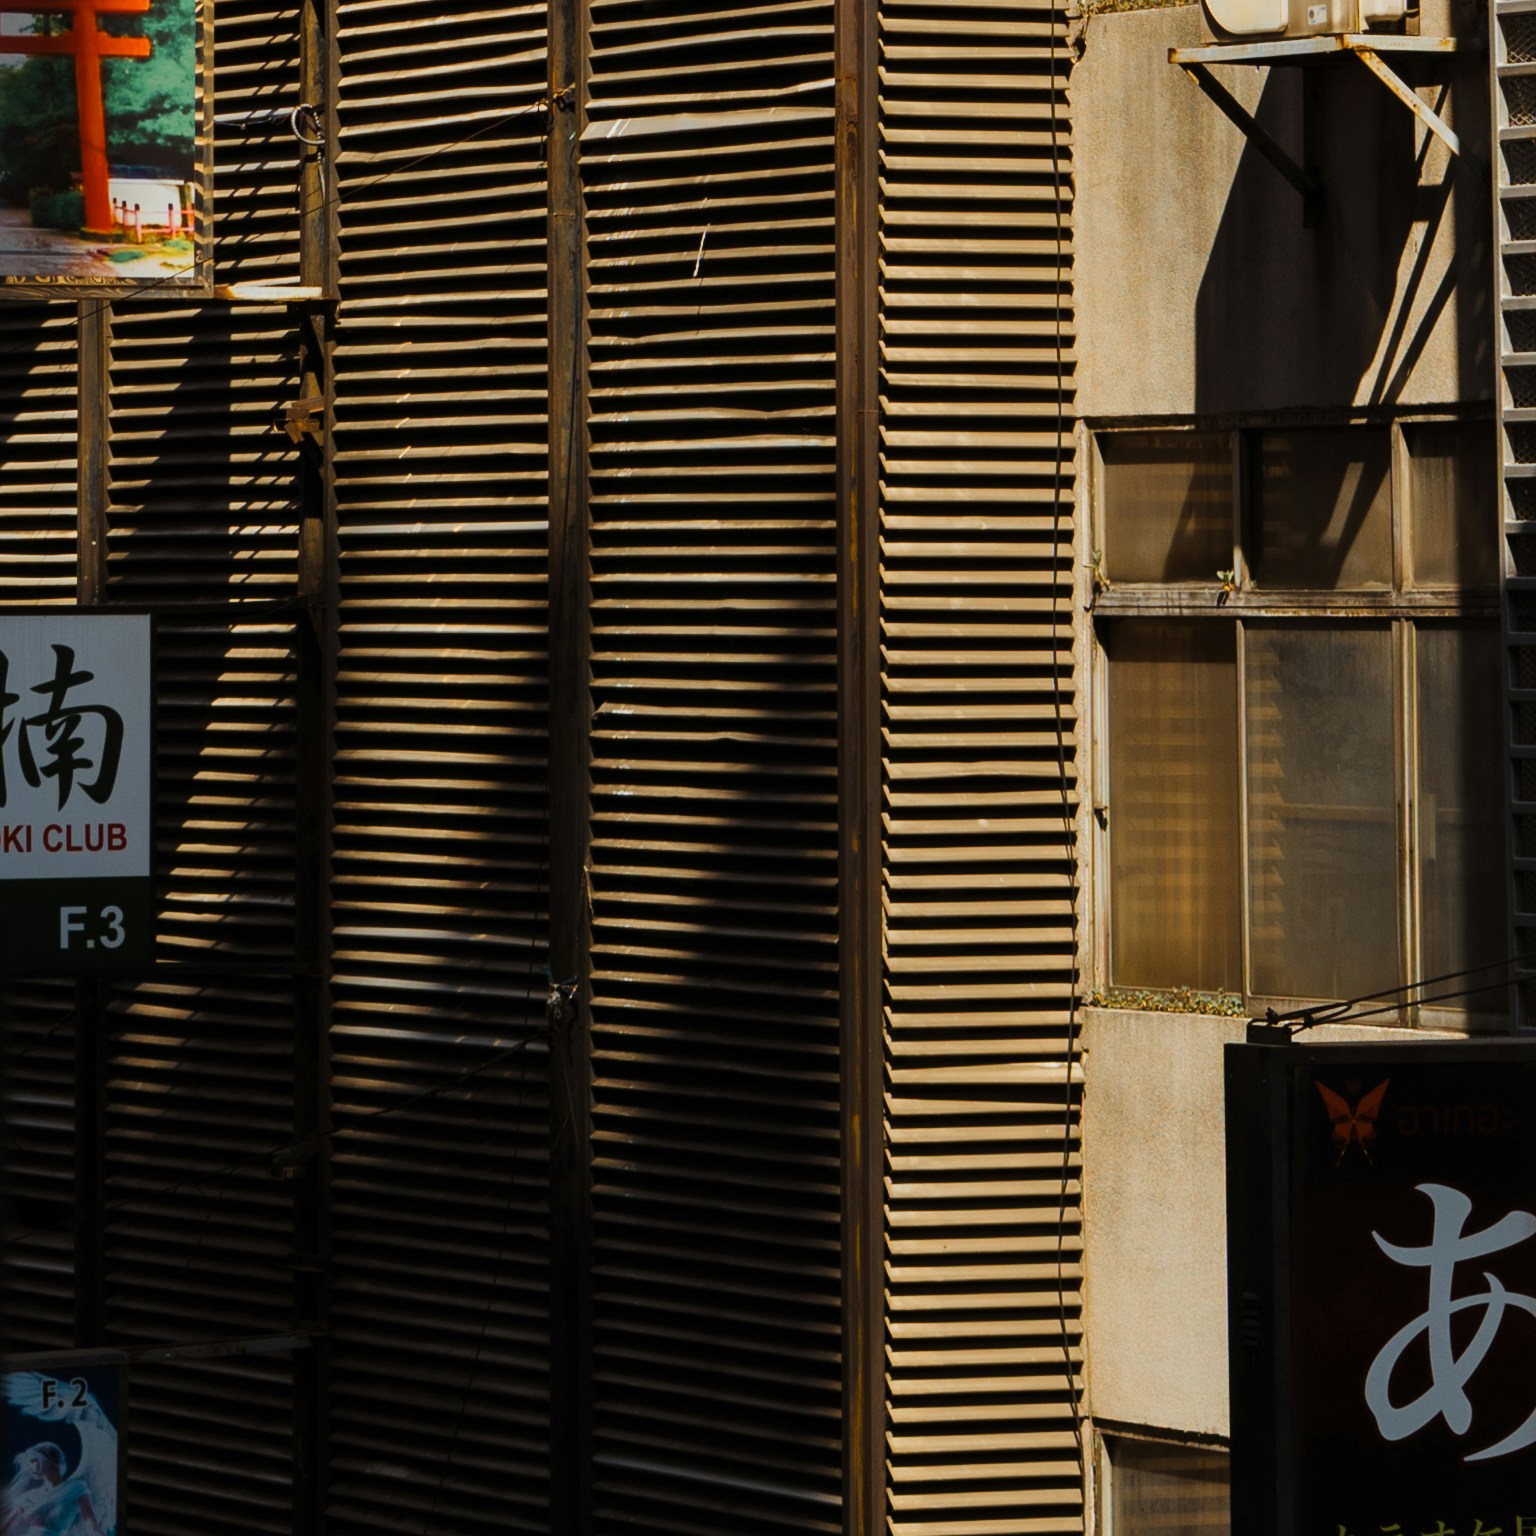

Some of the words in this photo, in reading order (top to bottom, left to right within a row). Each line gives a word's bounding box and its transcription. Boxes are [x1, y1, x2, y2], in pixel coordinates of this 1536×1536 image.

[42, 822, 129, 854] CLUB
[58, 905, 126, 950] F.3
[1365, 1183, 1536, 1462] あ
[41, 1378, 89, 1409] F.2
